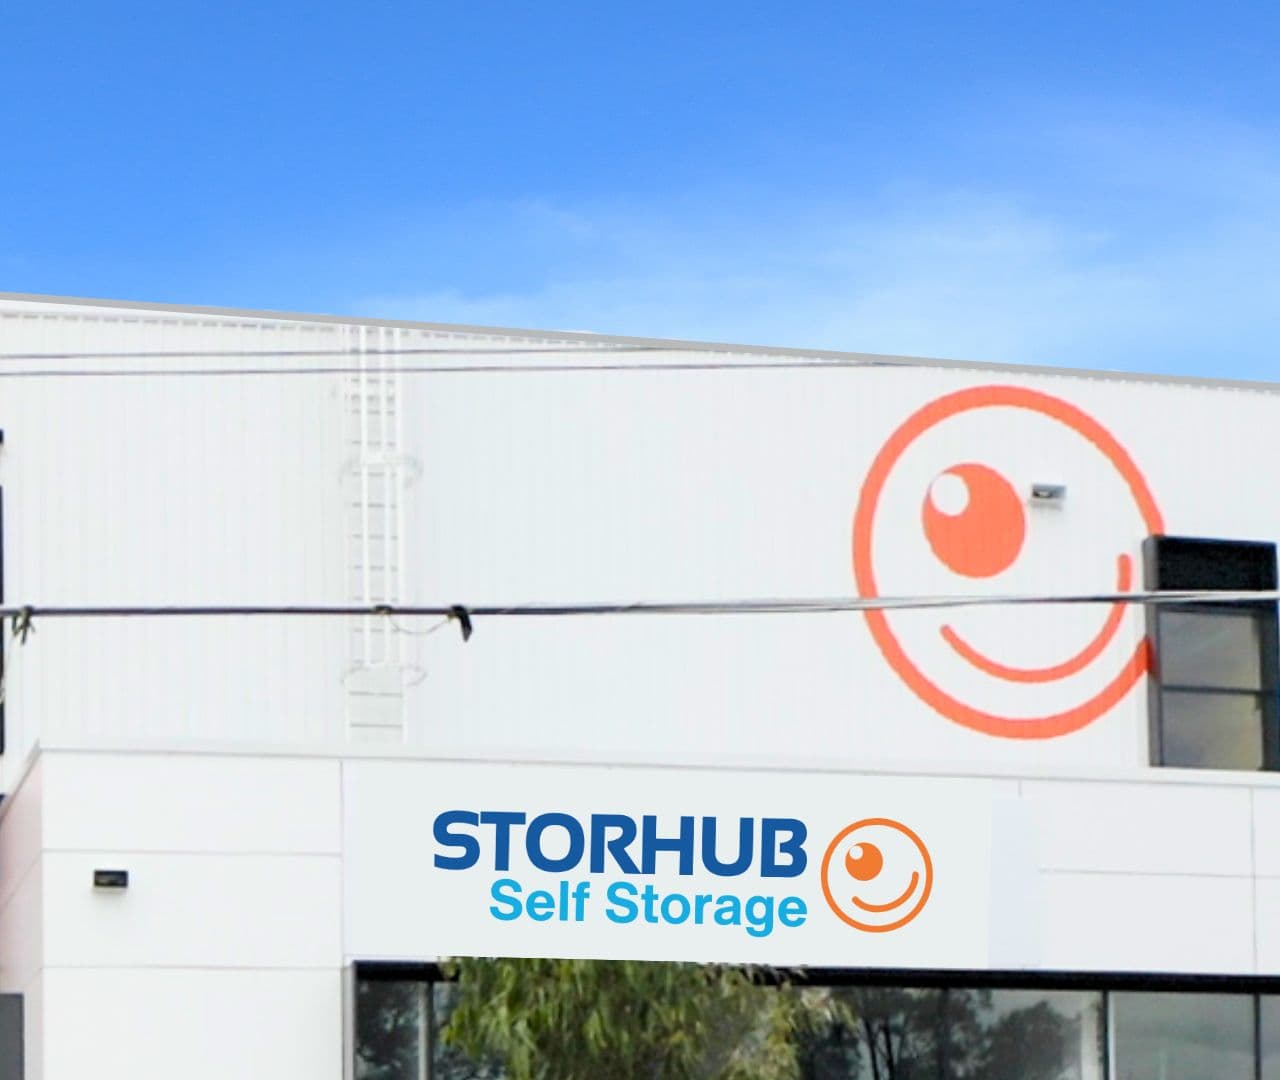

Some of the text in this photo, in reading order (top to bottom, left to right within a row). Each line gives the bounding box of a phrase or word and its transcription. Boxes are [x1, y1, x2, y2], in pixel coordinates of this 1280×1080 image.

[432, 809, 808, 878] STORHUB
[489, 878, 808, 938] Self Storage
